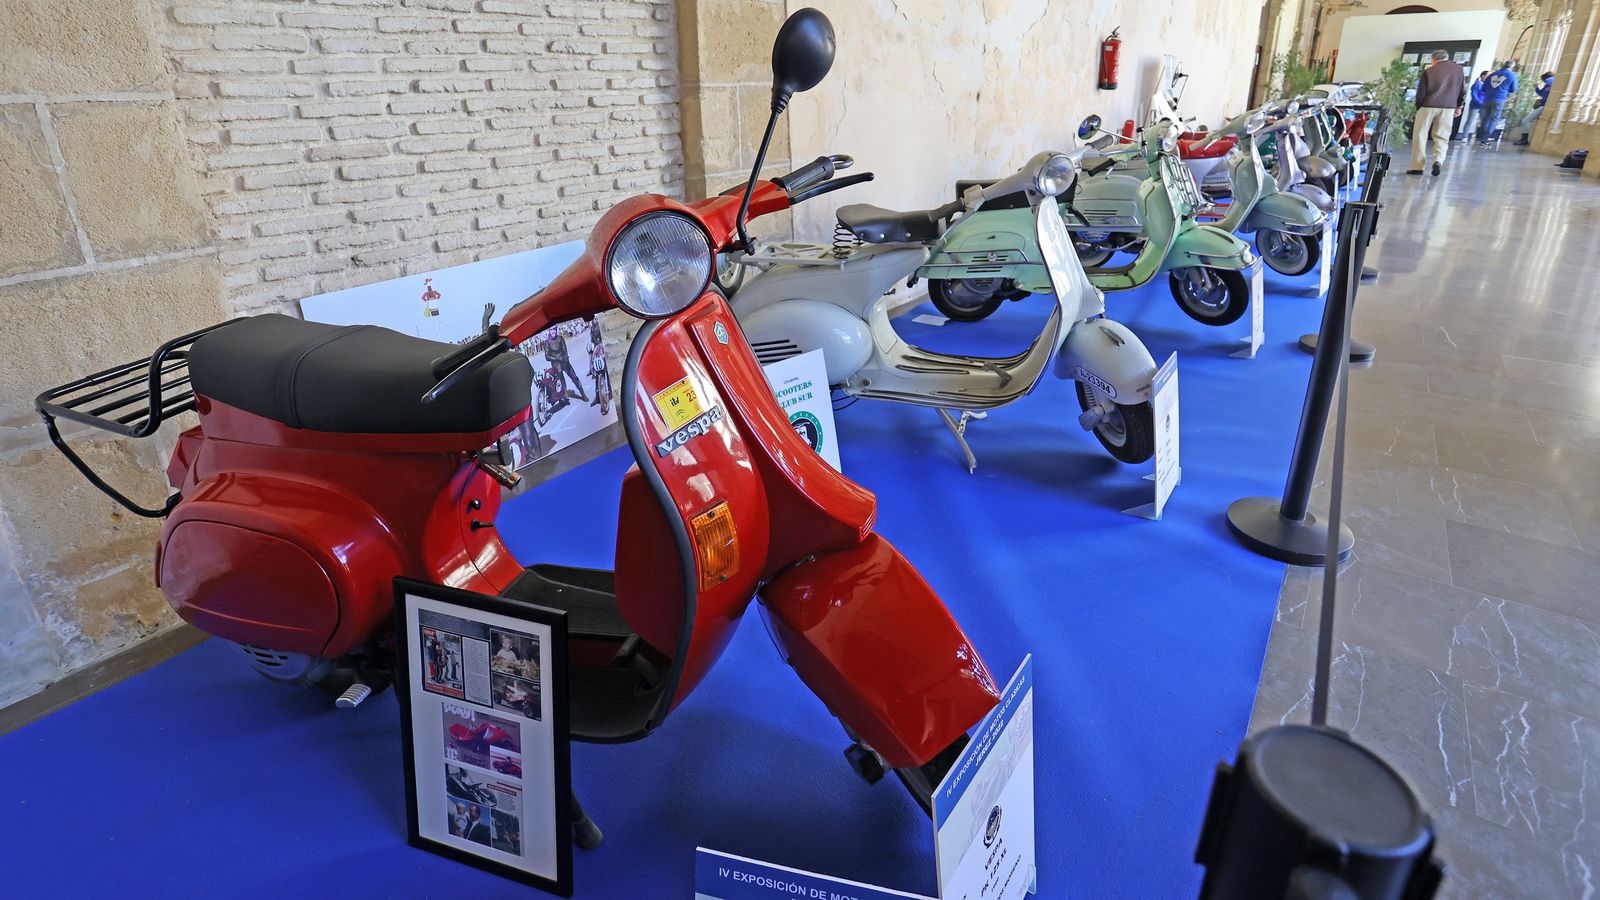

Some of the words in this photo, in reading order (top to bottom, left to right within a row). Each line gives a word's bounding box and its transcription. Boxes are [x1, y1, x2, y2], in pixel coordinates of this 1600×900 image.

[686, 389, 697, 403] 23
[780, 396, 799, 409] LUB
[799, 391, 813, 403] SUR
[658, 405, 722, 452] vespa
[989, 705, 1005, 733] MOTOS
[975, 738, 992, 767] JEREZ
[985, 837, 1003, 870] VESPA
[719, 867, 731, 878] IV
[733, 870, 807, 896] EXPOSICIÓN
[810, 888, 827, 900] DE
